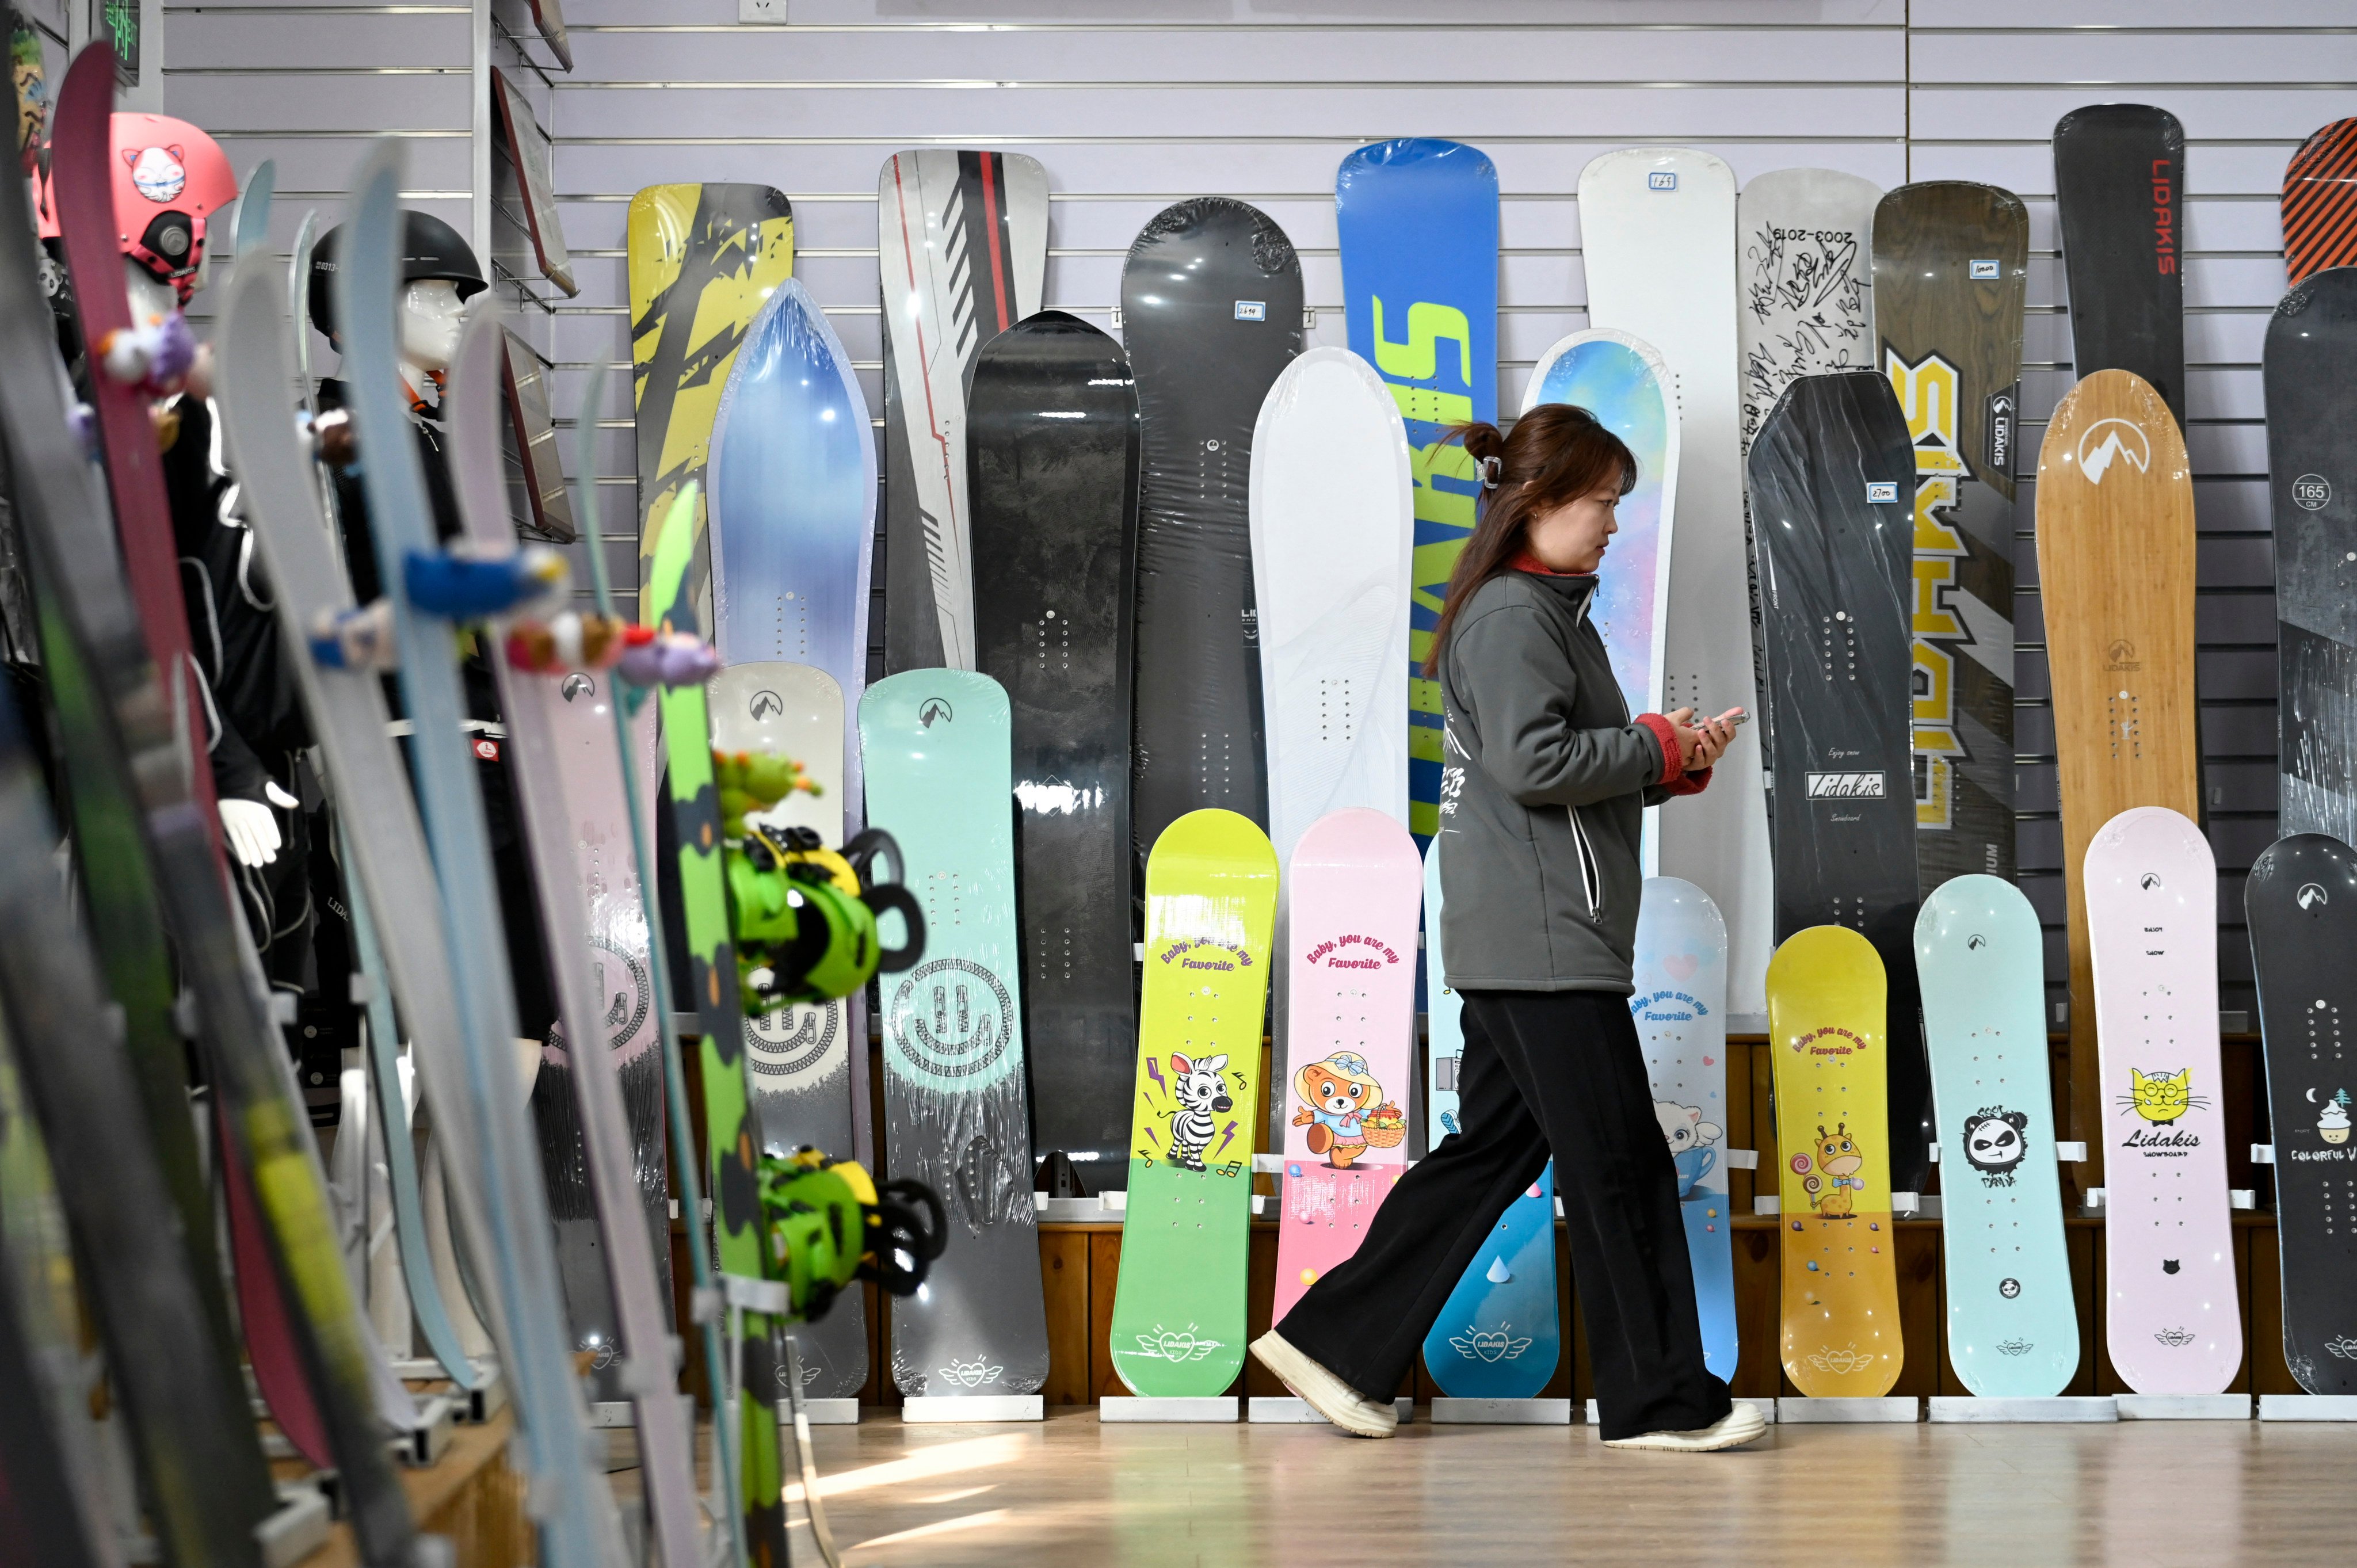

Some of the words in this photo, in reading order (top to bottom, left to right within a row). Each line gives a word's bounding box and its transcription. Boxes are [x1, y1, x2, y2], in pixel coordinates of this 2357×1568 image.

[2151, 159, 2176, 275] LIDAKIS
[1772, 228, 1852, 243] 2003-2019
[1994, 417, 2005, 466] LIDAKIS
[1872, 489, 1890, 498] 2700
[2299, 485, 2324, 498] 165
[1828, 747, 1845, 759] Enjoy
[1810, 774, 1881, 797] Lidakis
[1830, 813, 1862, 822] Snowboard
[327, 896, 349, 922] LIDA
[1161, 941, 1191, 964] Baby,
[1236, 950, 1253, 966] my
[1307, 940, 1337, 964] Baby,
[1339, 934, 1362, 947] you
[1364, 936, 1384, 950] are
[1382, 947, 1399, 964] my
[1182, 958, 1235, 971] Favorite
[1328, 957, 1382, 970] Favorite
[1631, 997, 1652, 1016] aby,
[1653, 991, 1673, 1002] you
[1675, 992, 1694, 1004] are
[1692, 1001, 1708, 1016] my
[1645, 1012, 1692, 1021] Favorite
[1792, 1033, 1816, 1053] Baby,
[1817, 1027, 1835, 1038] you
[1837, 1028, 1853, 1039] are
[1852, 1036, 1867, 1050] my
[1810, 1046, 1852, 1055] Favorite
[2122, 1129, 2200, 1147] Lidakis
[2291, 1150, 2344, 1162] COLORFUL
[1164, 1341, 1191, 1349] LIDAKIS
